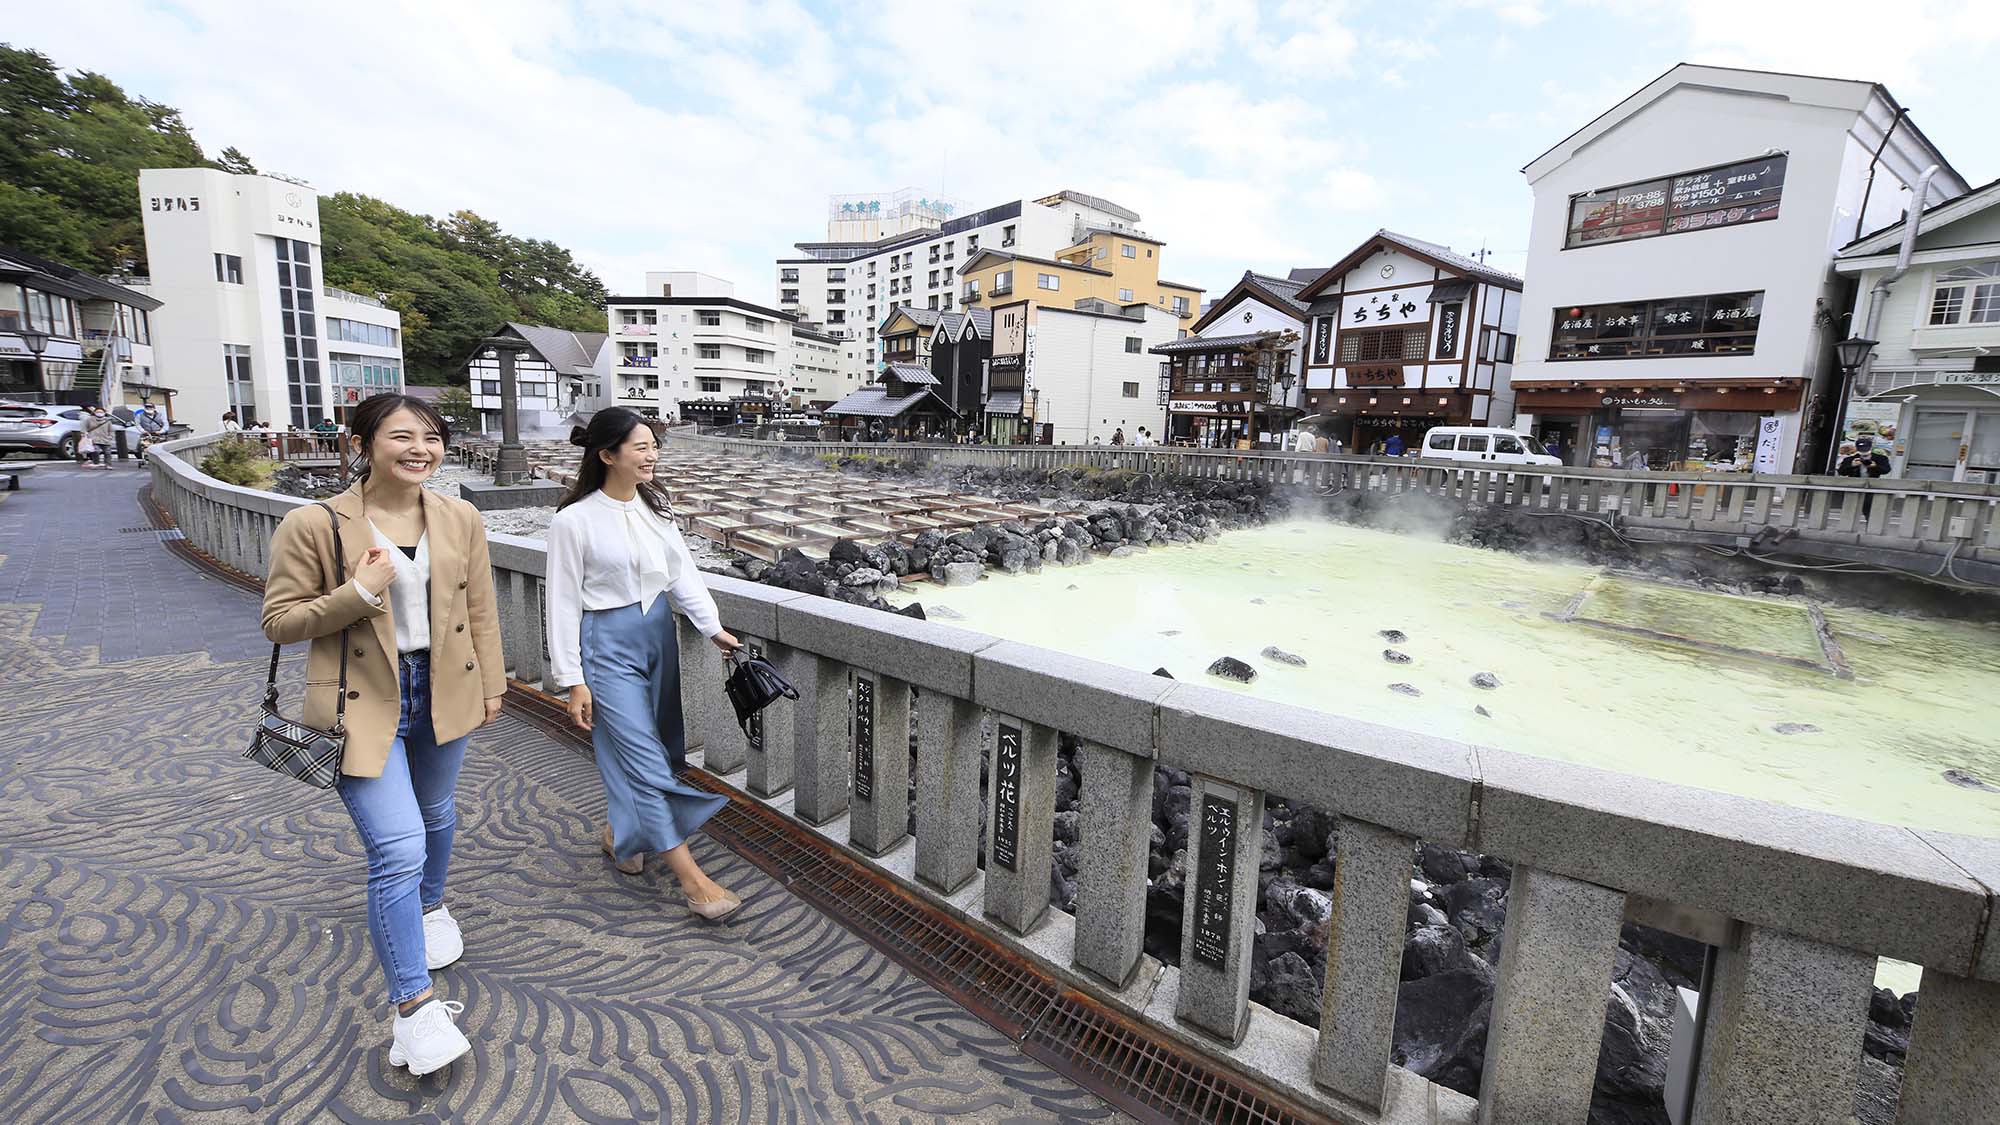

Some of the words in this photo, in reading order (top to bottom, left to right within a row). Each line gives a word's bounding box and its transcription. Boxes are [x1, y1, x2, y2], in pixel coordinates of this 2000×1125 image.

[1676, 174, 1712, 187] カラオケ
[1617, 190, 1665, 205] 0279-88-
[1637, 197, 1665, 209] 3788
[1690, 186, 1726, 200] ¥1500
[1672, 207, 1747, 231] カラオケ
[1353, 301, 1417, 323] ちちや
[1561, 318, 1593, 330] 居酒屋
[1605, 315, 1640, 327] お食事
[1664, 311, 1693, 324] 喫茶
[1712, 306, 1757, 320] 居酒屋
[1000, 734, 1017, 804] ベルツ花
[1207, 804, 1218, 835] ベルツ
